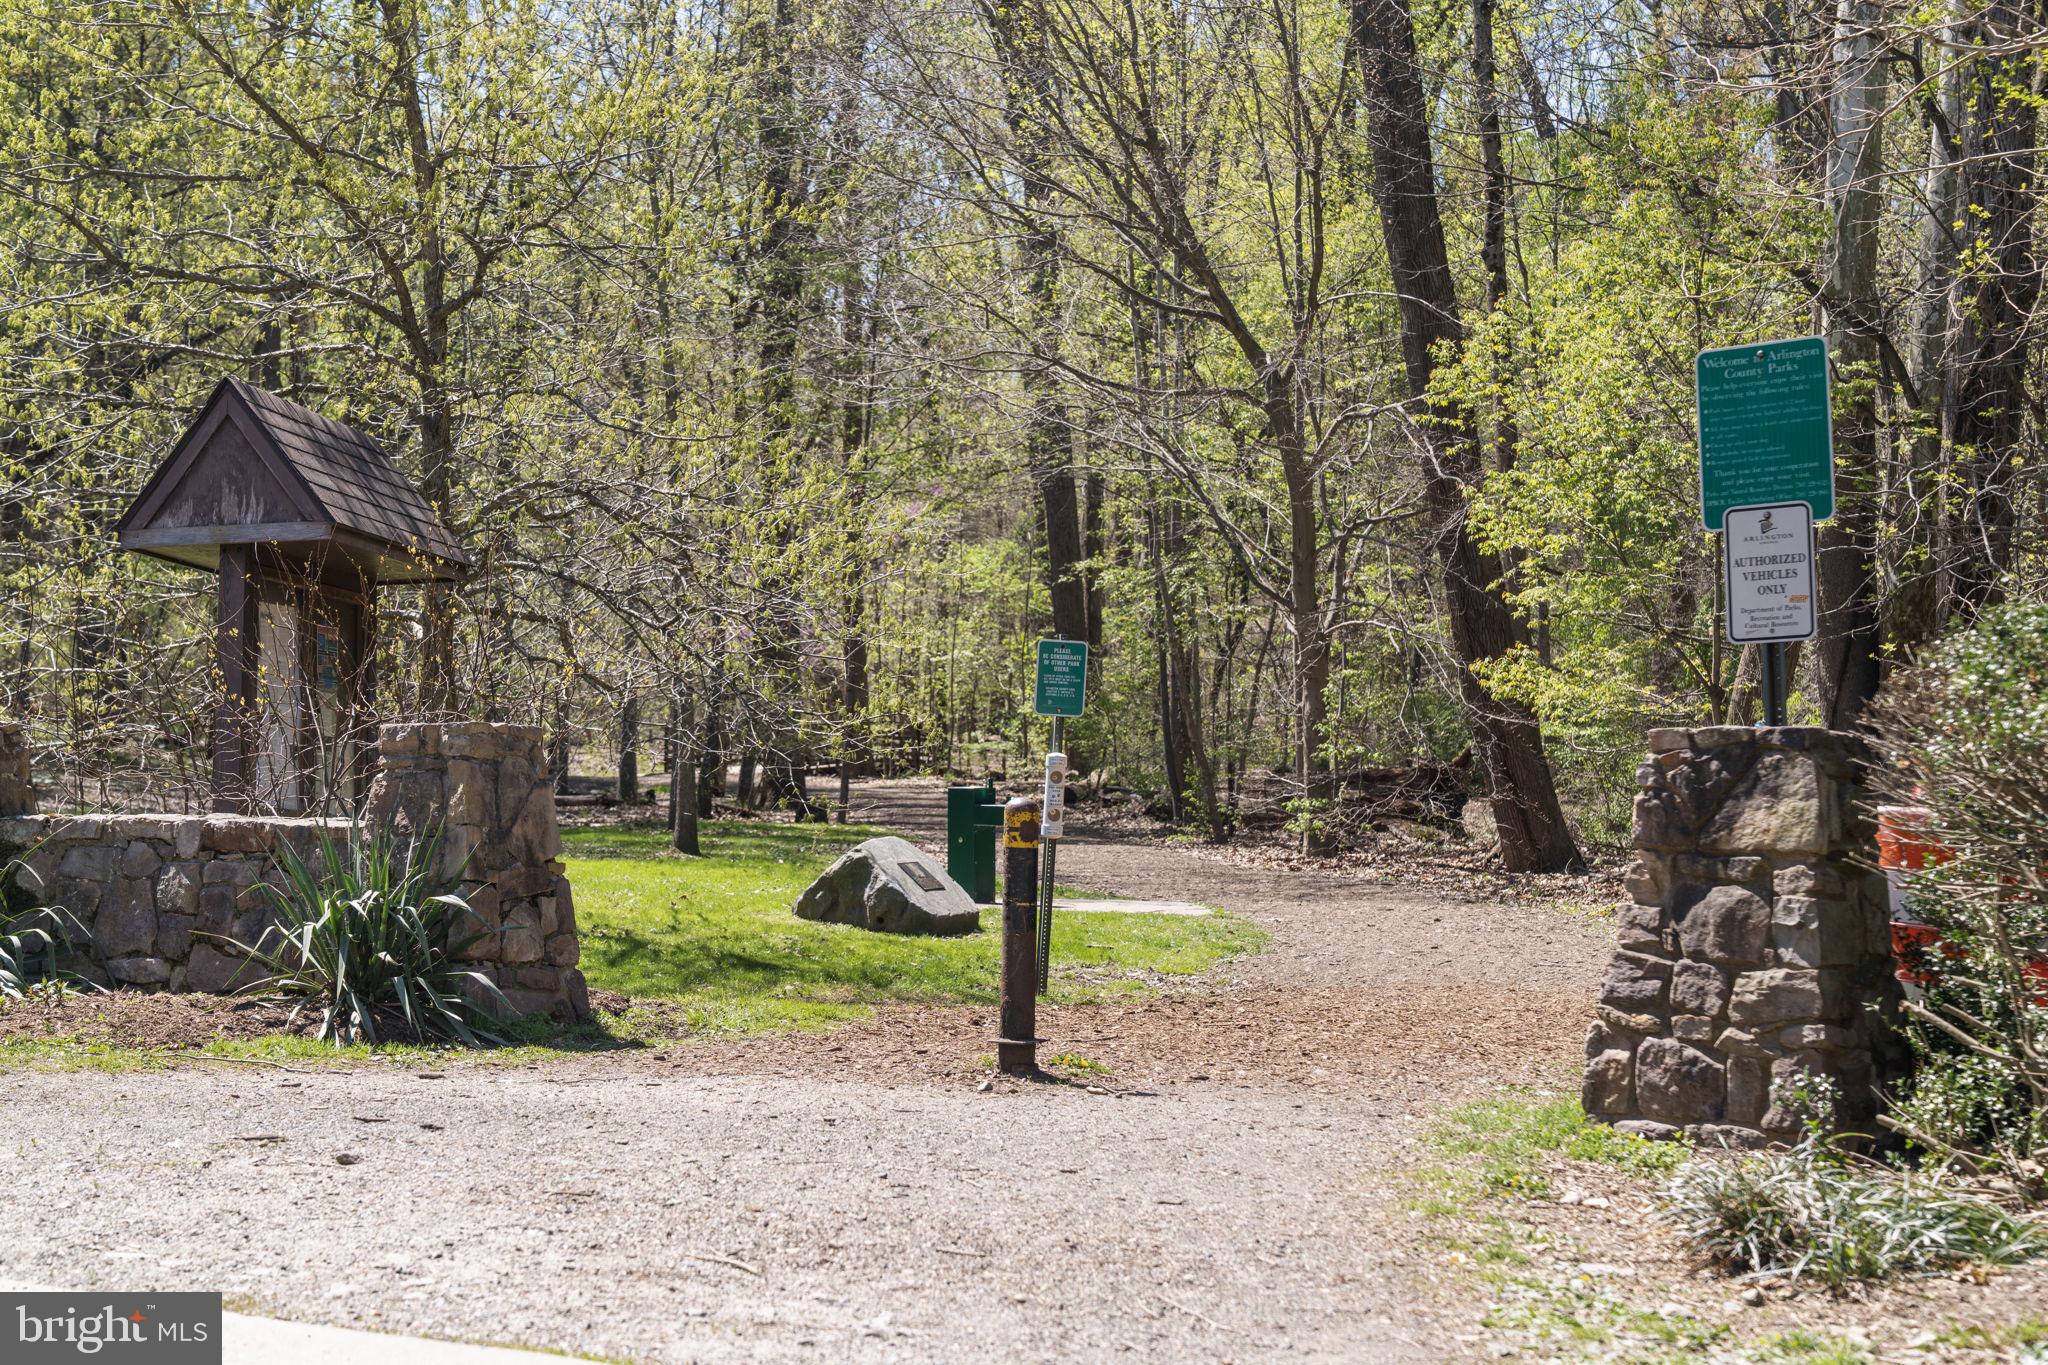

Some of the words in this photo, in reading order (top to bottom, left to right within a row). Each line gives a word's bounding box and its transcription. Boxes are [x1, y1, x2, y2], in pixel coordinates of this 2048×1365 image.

[1703, 357, 1749, 369] Welcome
[1768, 347, 1820, 361] Arlington
[1724, 366, 1764, 379] County
[1768, 361, 1799, 374] Parks
[1743, 533, 1794, 543] ARLINGTON
[1733, 552, 1807, 568] AUTHORIZED
[1742, 568, 1799, 581] VEHICLES
[1757, 584, 1788, 596] ONLY
[1740, 606, 1775, 615] Department
[1744, 621, 1769, 629] Cultural
[1050, 653, 1082, 661] CONSIDERATE
